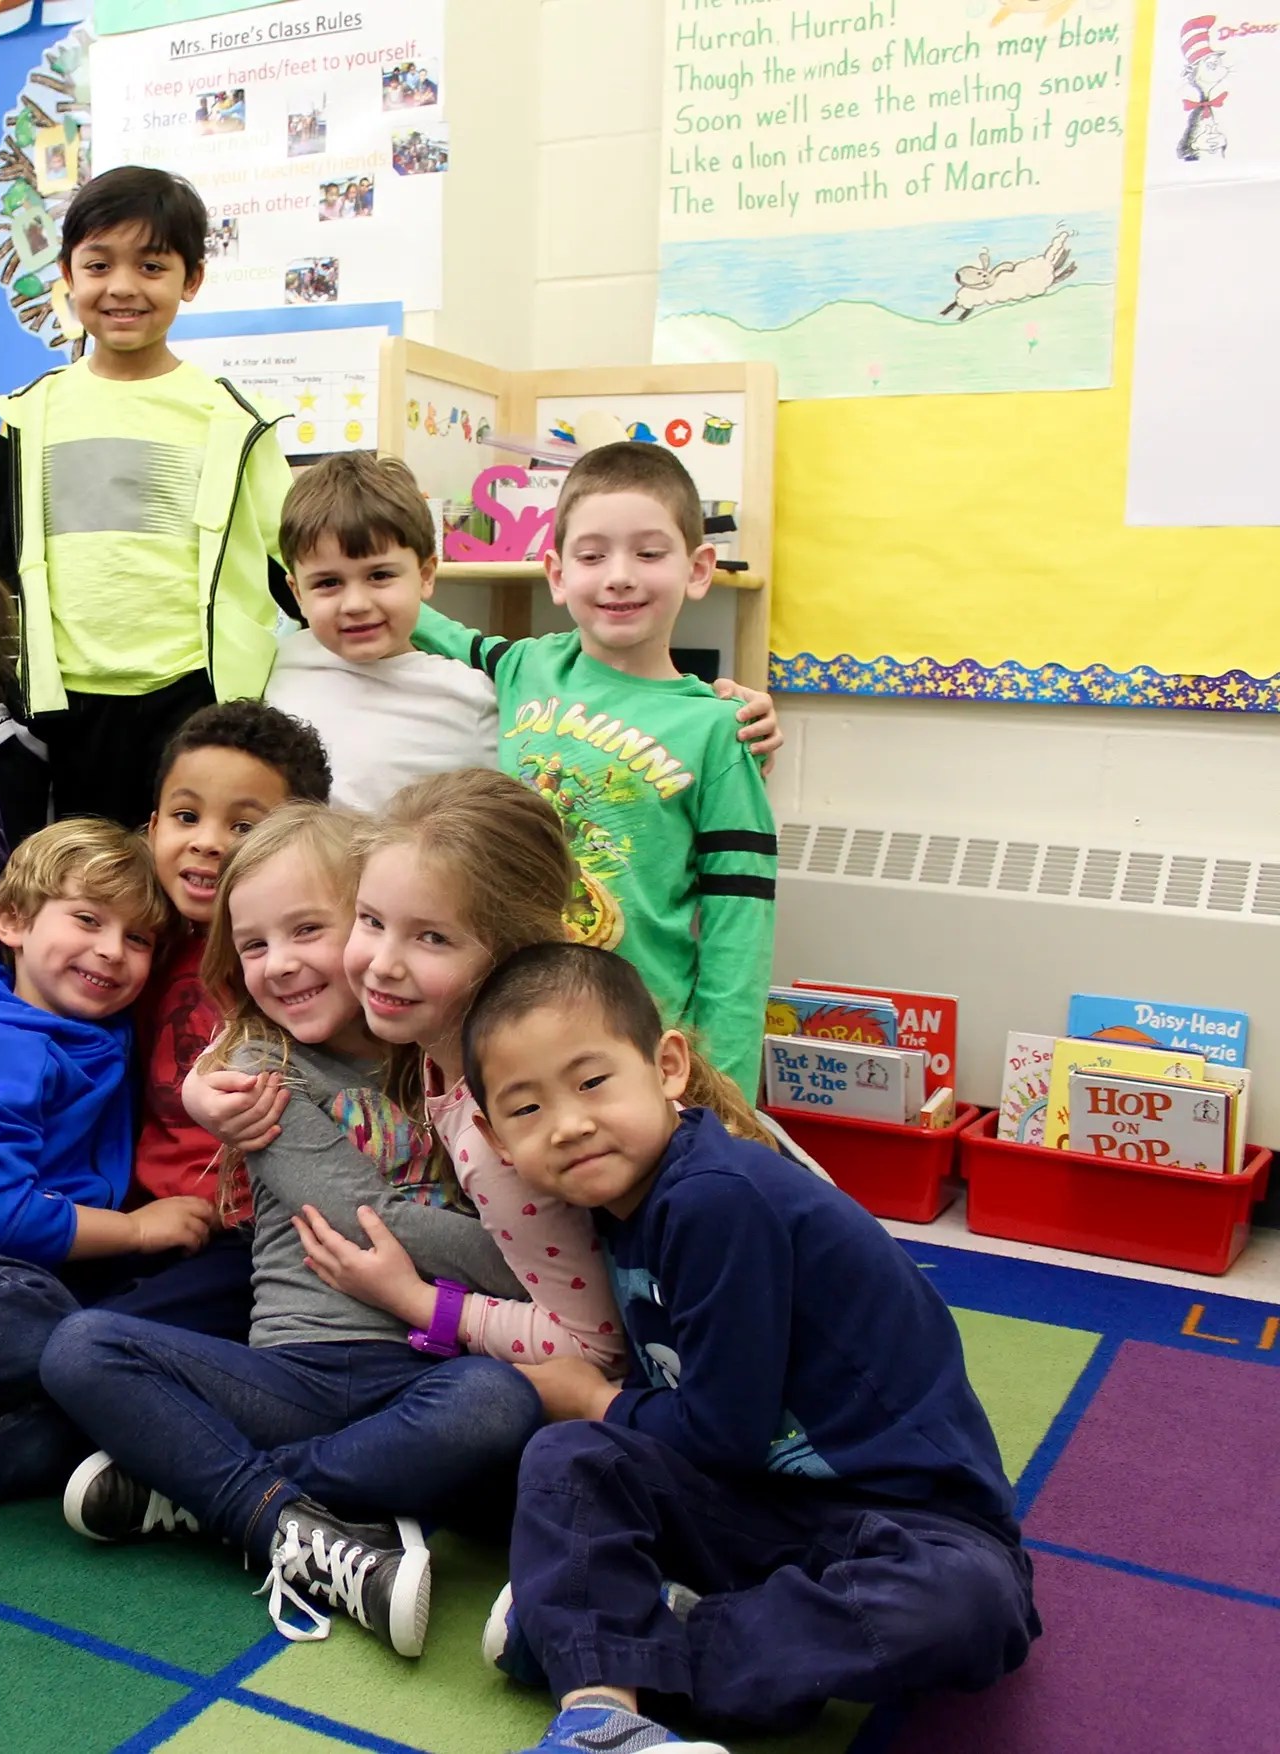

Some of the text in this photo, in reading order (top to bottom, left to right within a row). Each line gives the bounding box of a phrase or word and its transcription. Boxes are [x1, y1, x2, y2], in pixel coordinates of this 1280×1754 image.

[170, 11, 362, 56] Mrs. Fiore's Class Rules
[790, 0, 895, 41] Hurrah!
[144, 80, 183, 97] Keep
[188, 73, 222, 94] your
[228, 57, 317, 84] hands/feet
[323, 54, 340, 69] to
[345, 40, 422, 67] yourself.
[673, 15, 1119, 101] Though the winds of March may blow,
[143, 109, 192, 130] Share.
[673, 104, 742, 134] Soon
[821, 102, 860, 121] see
[875, 84, 915, 114] the
[929, 73, 1021, 112] melting
[669, 108, 1124, 175] Like a lion it comes and a lamb it goes,
[670, 157, 1041, 218] The lovely month of March.
[223, 196, 261, 217] each
[265, 191, 317, 213] other.
[556, 703, 695, 800] WANNA
[766, 1013, 785, 1027] he
[897, 1008, 942, 1034] AN
[1134, 1004, 1240, 1038] Daisy-Head
[900, 1034, 927, 1047] The
[772, 1047, 848, 1074] Put Me
[1009, 1057, 1032, 1071] Dr.
[777, 1066, 802, 1085] in
[808, 1071, 848, 1091] the
[790, 1085, 834, 1105] Zoo
[1085, 1086, 1173, 1122] HOP
[1112, 1121, 1140, 1134] ON
[1087, 1134, 1171, 1166] POP
